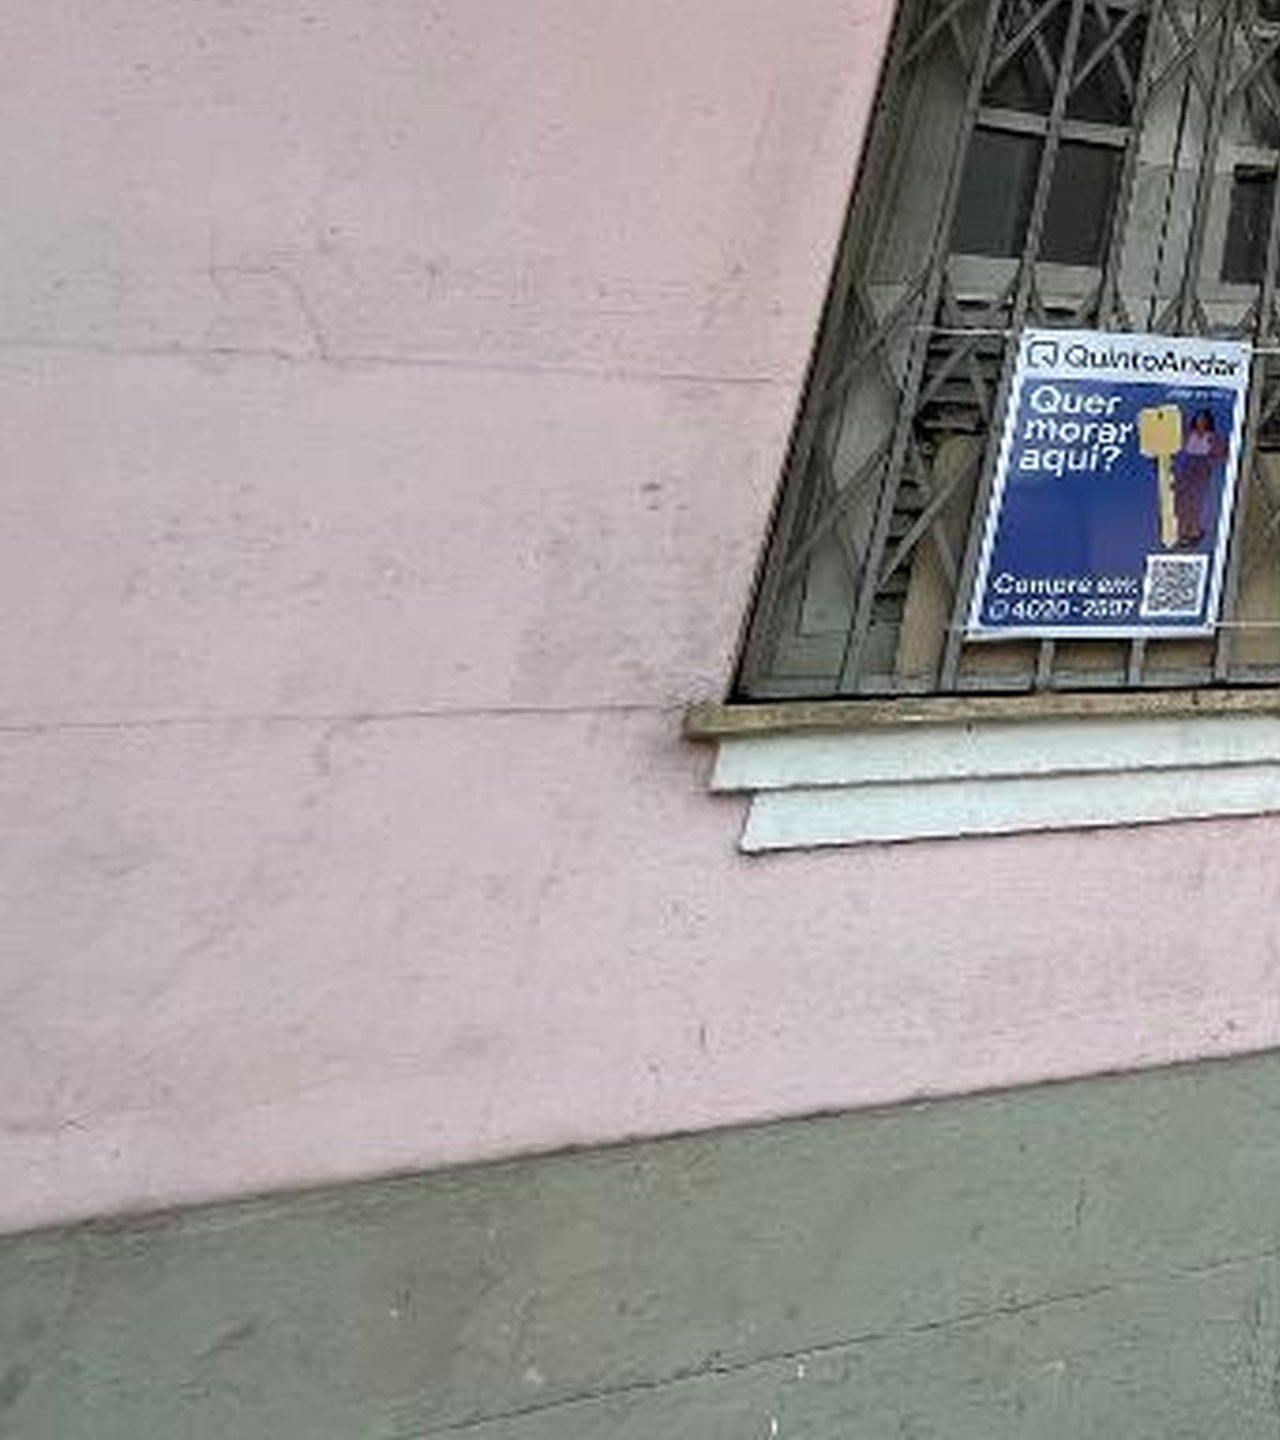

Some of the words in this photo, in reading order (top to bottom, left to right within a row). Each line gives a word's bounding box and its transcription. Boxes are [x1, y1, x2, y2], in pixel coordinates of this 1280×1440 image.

[1065, 345, 1239, 377] QuintoAndar
[1030, 386, 1122, 413] Quer
[1023, 418, 1132, 444] morar
[1019, 444, 1122, 476] aqui?
[993, 573, 1091, 597] Compre
